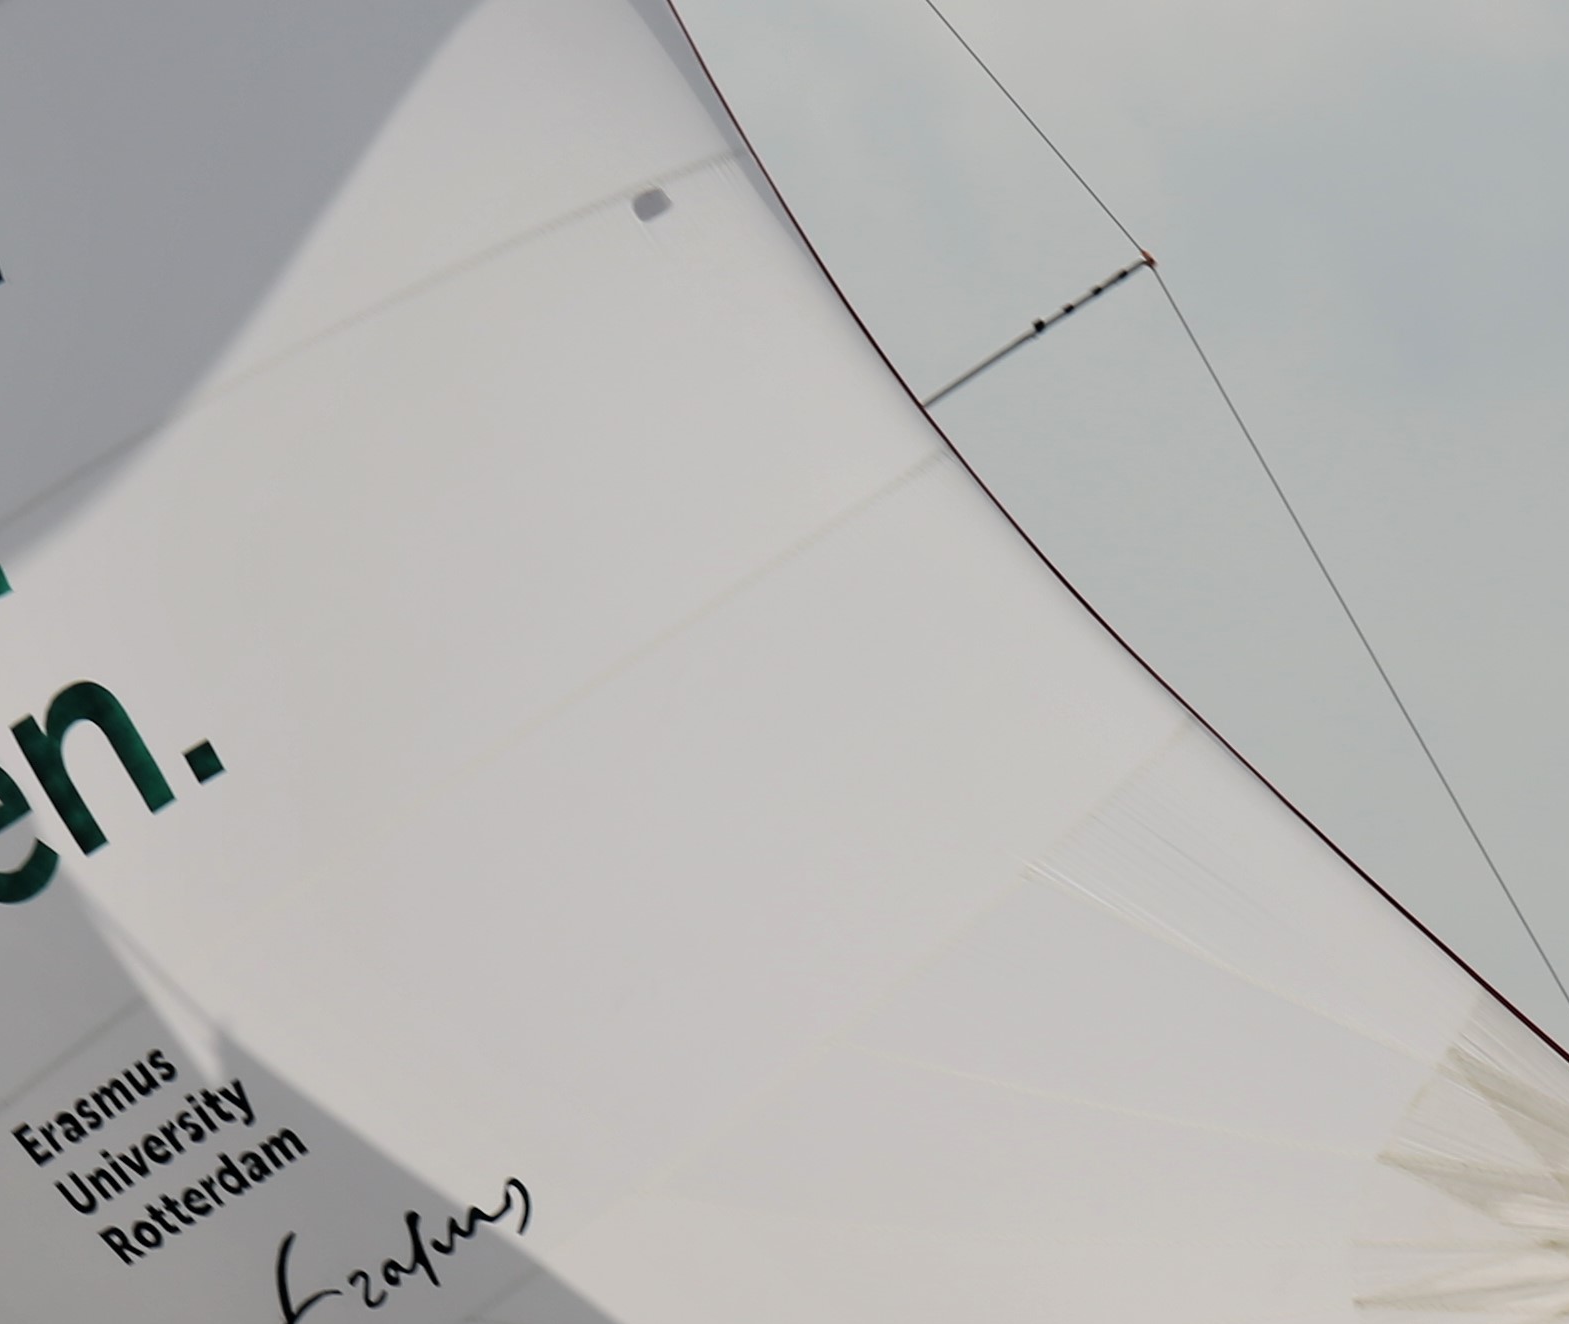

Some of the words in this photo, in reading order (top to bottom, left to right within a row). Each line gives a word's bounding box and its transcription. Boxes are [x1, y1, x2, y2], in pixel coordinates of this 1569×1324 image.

[11, 1048, 178, 1167] Erasmus
[54, 1078, 256, 1216] University
[97, 1127, 310, 1266] Rotterdam
